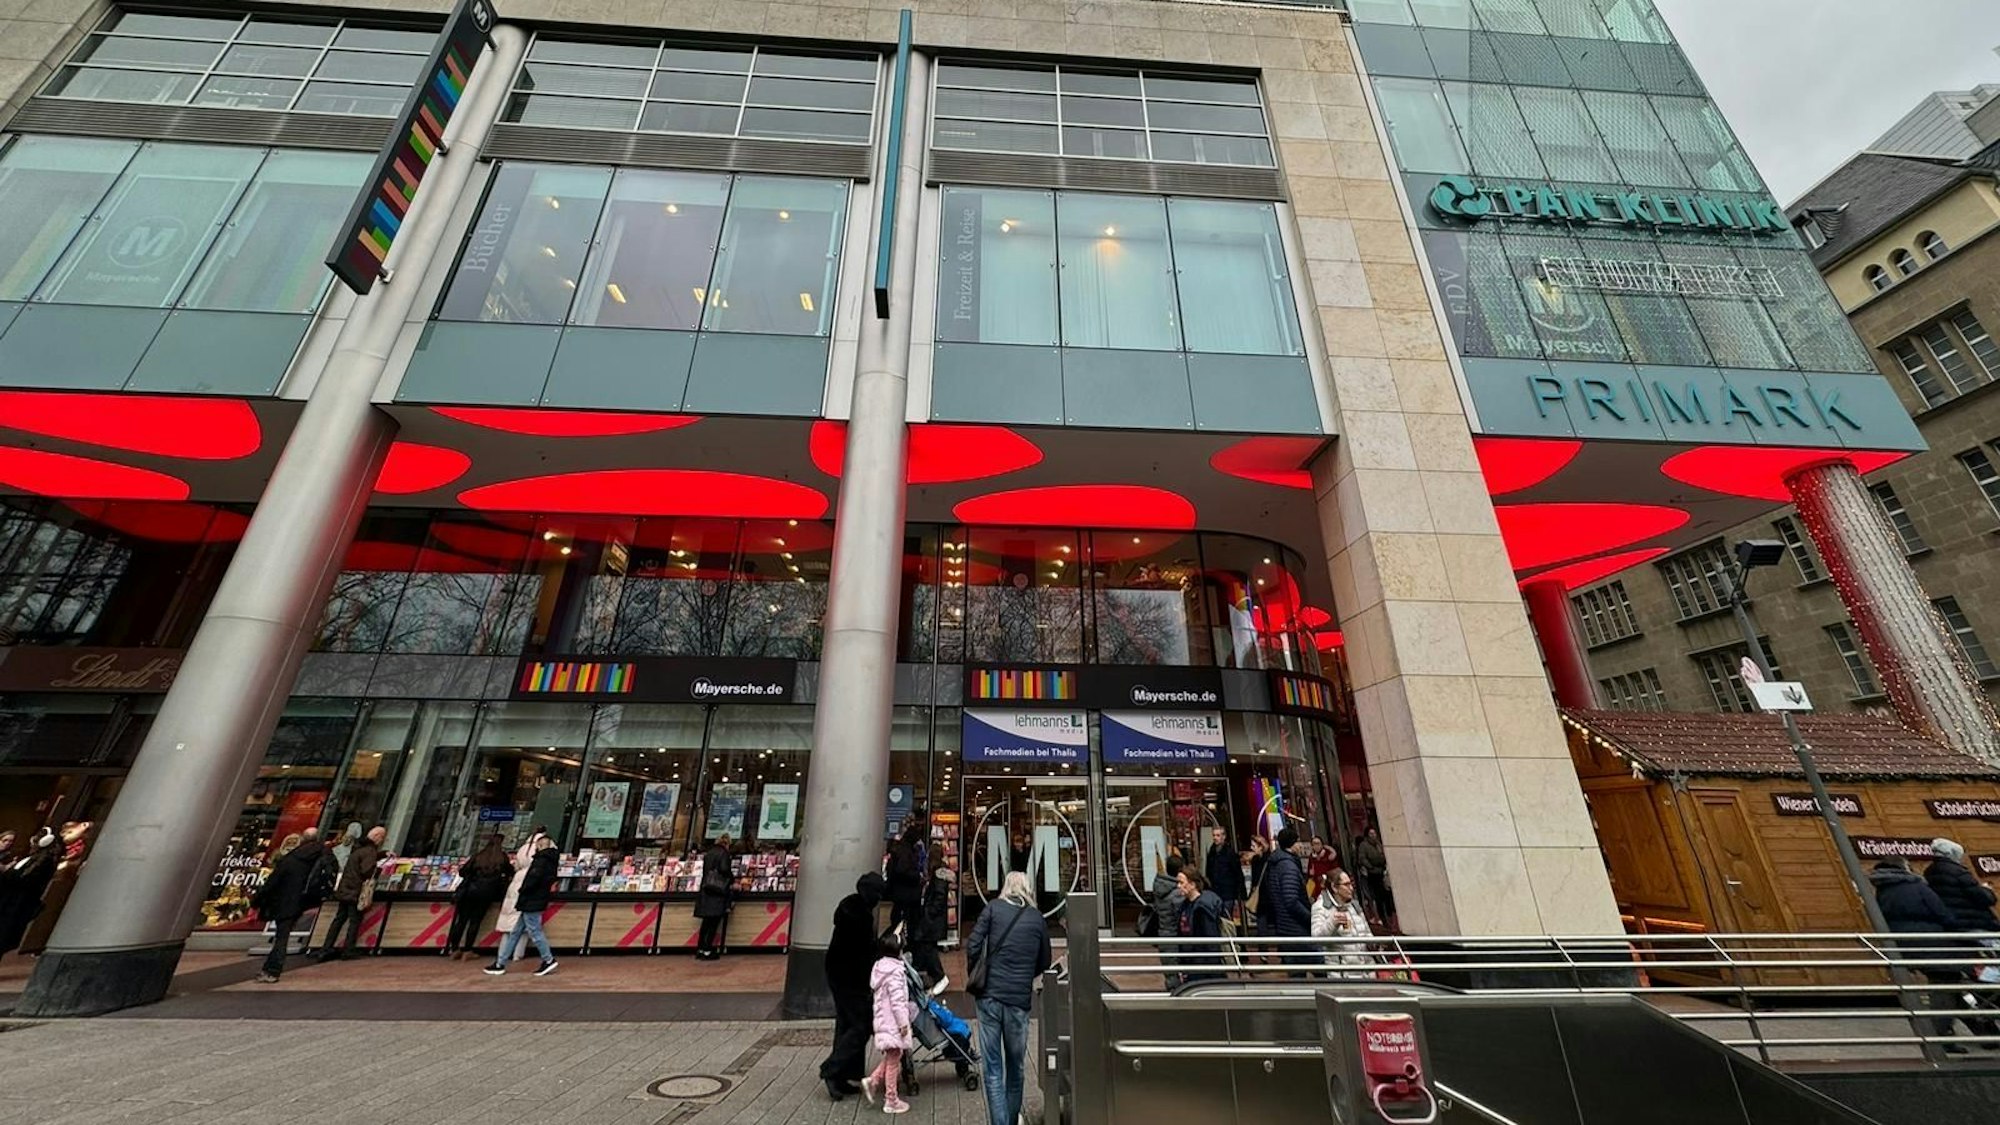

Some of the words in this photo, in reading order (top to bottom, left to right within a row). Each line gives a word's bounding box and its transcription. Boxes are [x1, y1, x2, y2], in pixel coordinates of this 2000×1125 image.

[1506, 185, 1605, 221] PAN
[1617, 192, 1789, 232] KLINIK
[957, 207, 976, 245] Reise
[463, 204, 512, 273] Bücher
[958, 250, 974, 262] &
[954, 265, 974, 320] Freizeit
[1527, 375, 1863, 431] PRIMARK
[51, 653, 170, 688] Lindt
[694, 681, 784, 696] Mayersche.de
[1134, 689, 1217, 703] Mayersche.de
[1015, 714, 1069, 728] lehmanns
[1152, 715, 1205, 729] lehmanns
[984, 747, 1035, 757] Fachmedien
[1036, 748, 1050, 756] bei
[1051, 748, 1077, 757] Thalia
[1124, 748, 1173, 758] Fachmedien
[1189, 749, 1215, 758] Thalia
[1857, 840, 1934, 856] Kräuterbonbon
[219, 855, 263, 867] rfektes
[211, 868, 269, 886] chenk
